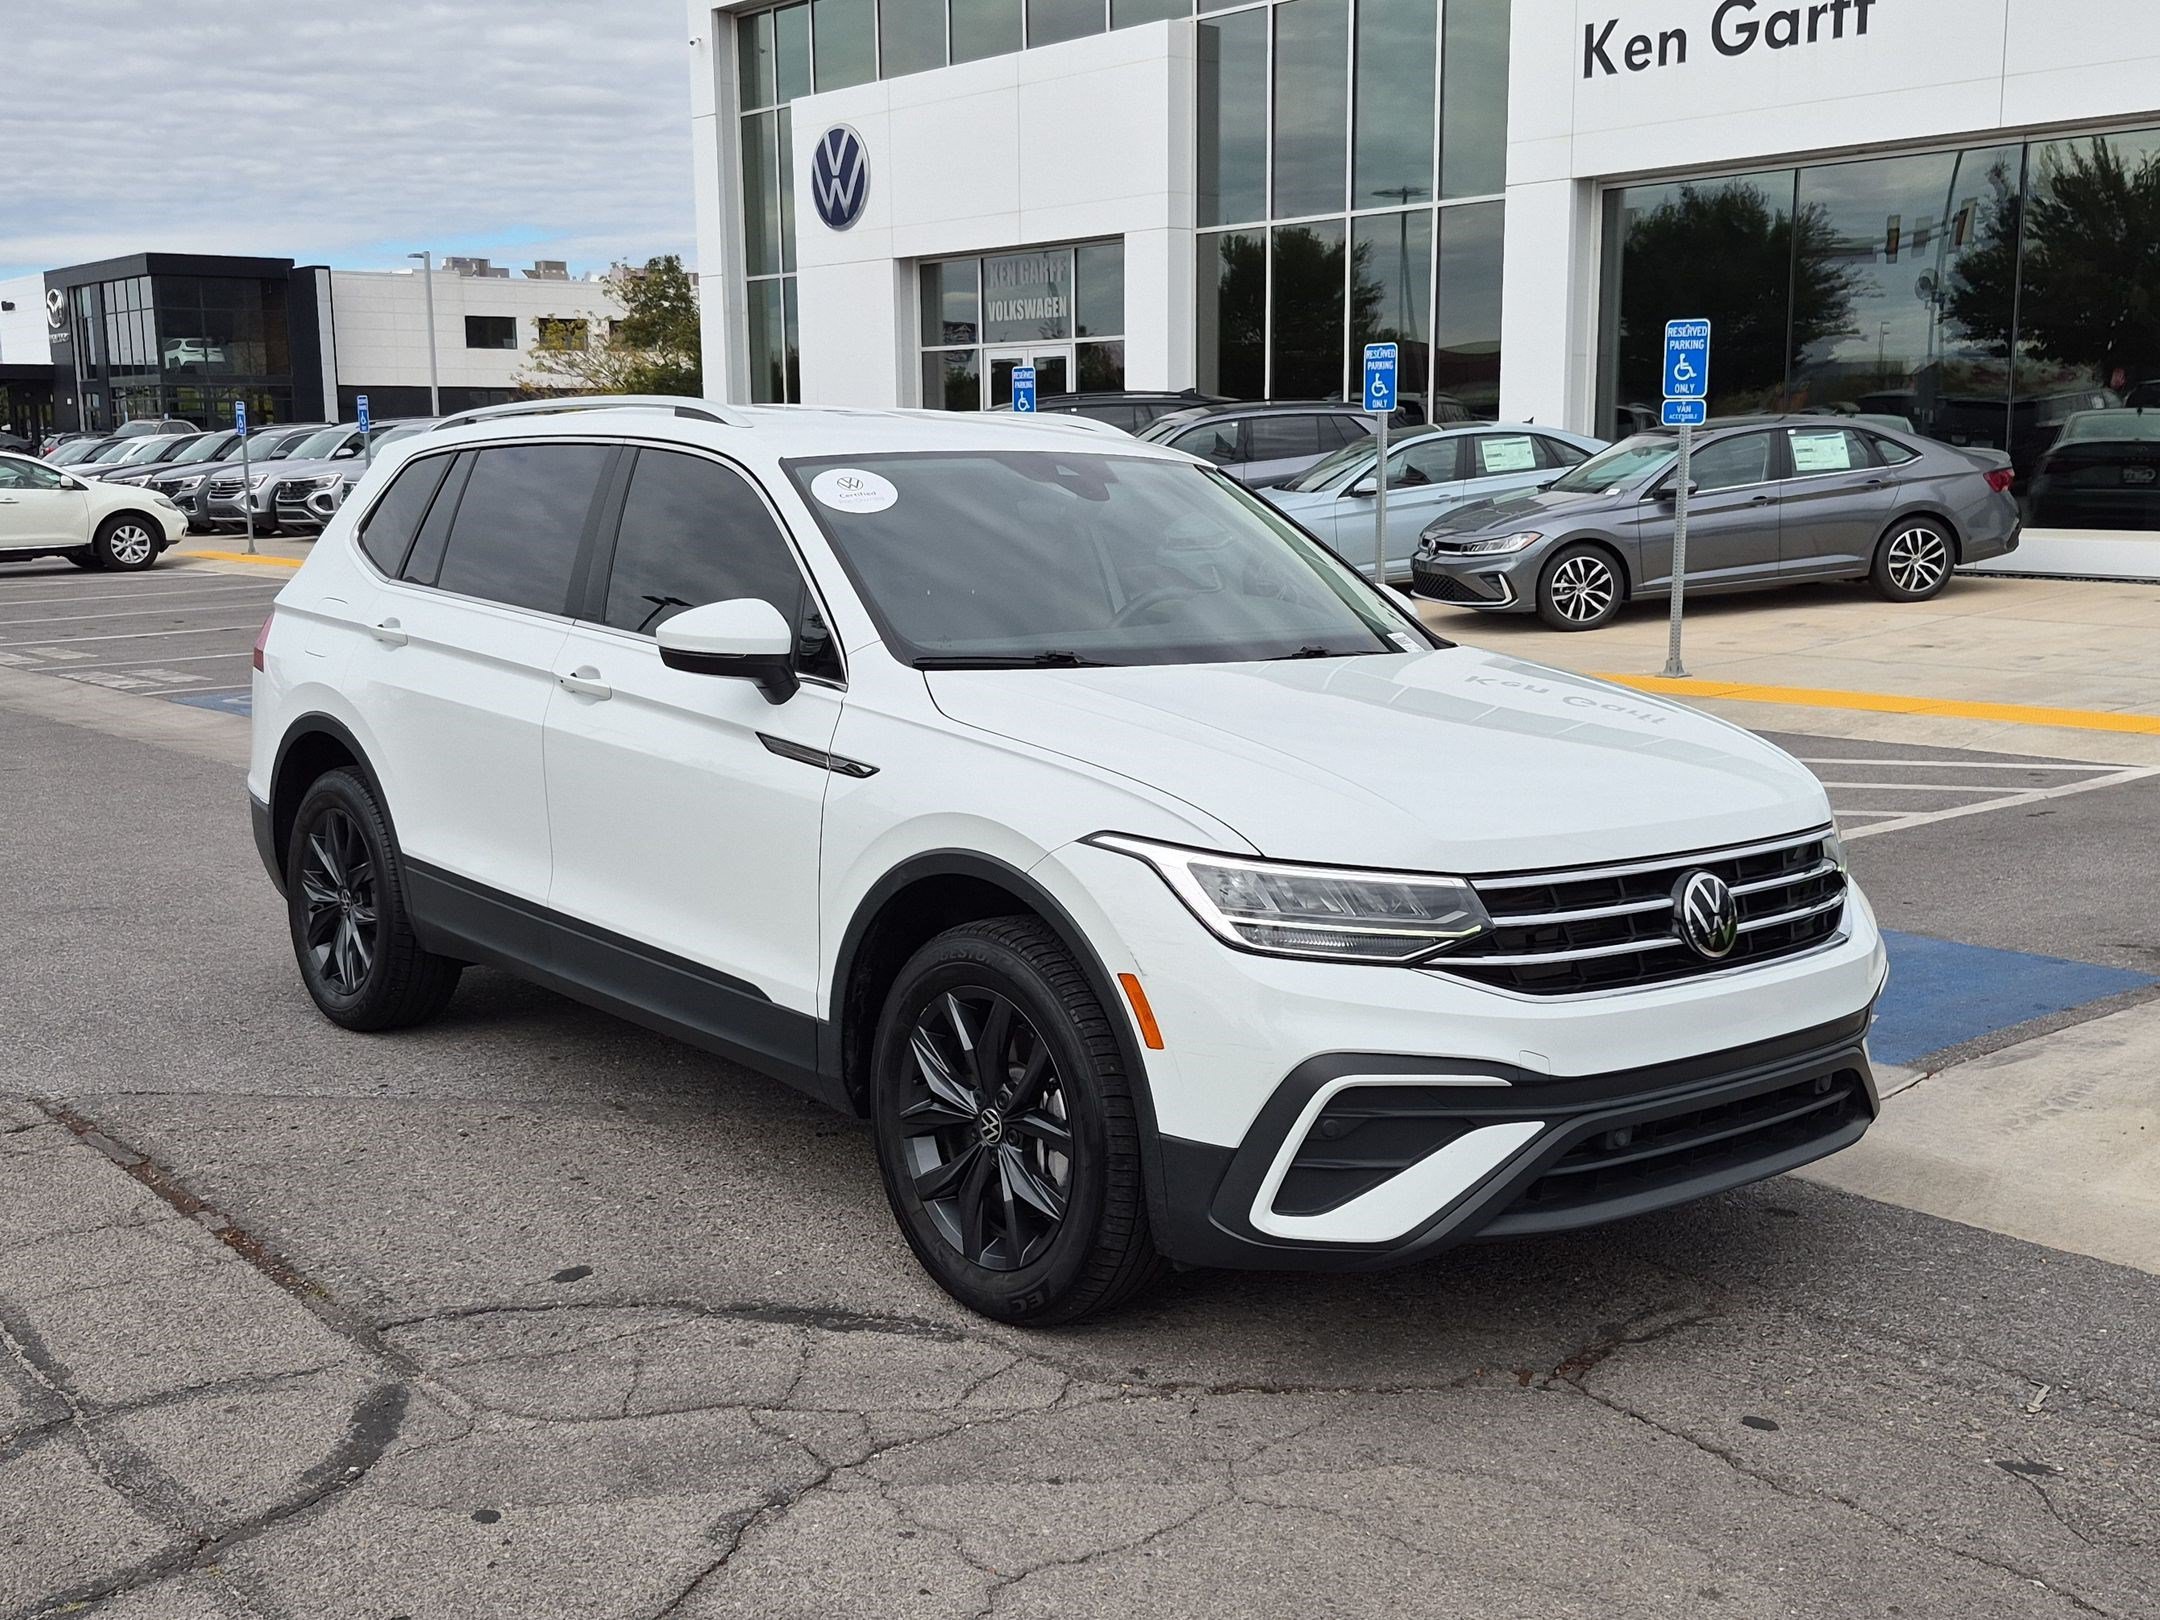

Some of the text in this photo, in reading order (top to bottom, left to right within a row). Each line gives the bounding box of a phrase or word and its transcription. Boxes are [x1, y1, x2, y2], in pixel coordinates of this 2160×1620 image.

[1583, 0, 1877, 79] Ken Garff
[811, 123, 871, 231] VW
[989, 256, 1067, 288] KEN GARFF
[988, 296, 1067, 322] VOLKSWAGEN
[1667, 325, 1708, 337] RESERVED
[1669, 339, 1705, 350] PARKING
[1365, 348, 1396, 360] RESERVED
[1367, 361, 1394, 371] PARKING
[1674, 383, 1695, 394] ONLY
[1372, 399, 1388, 409] ONLY
[1676, 405, 1692, 413] VAN
[839, 490, 877, 499] Certified
